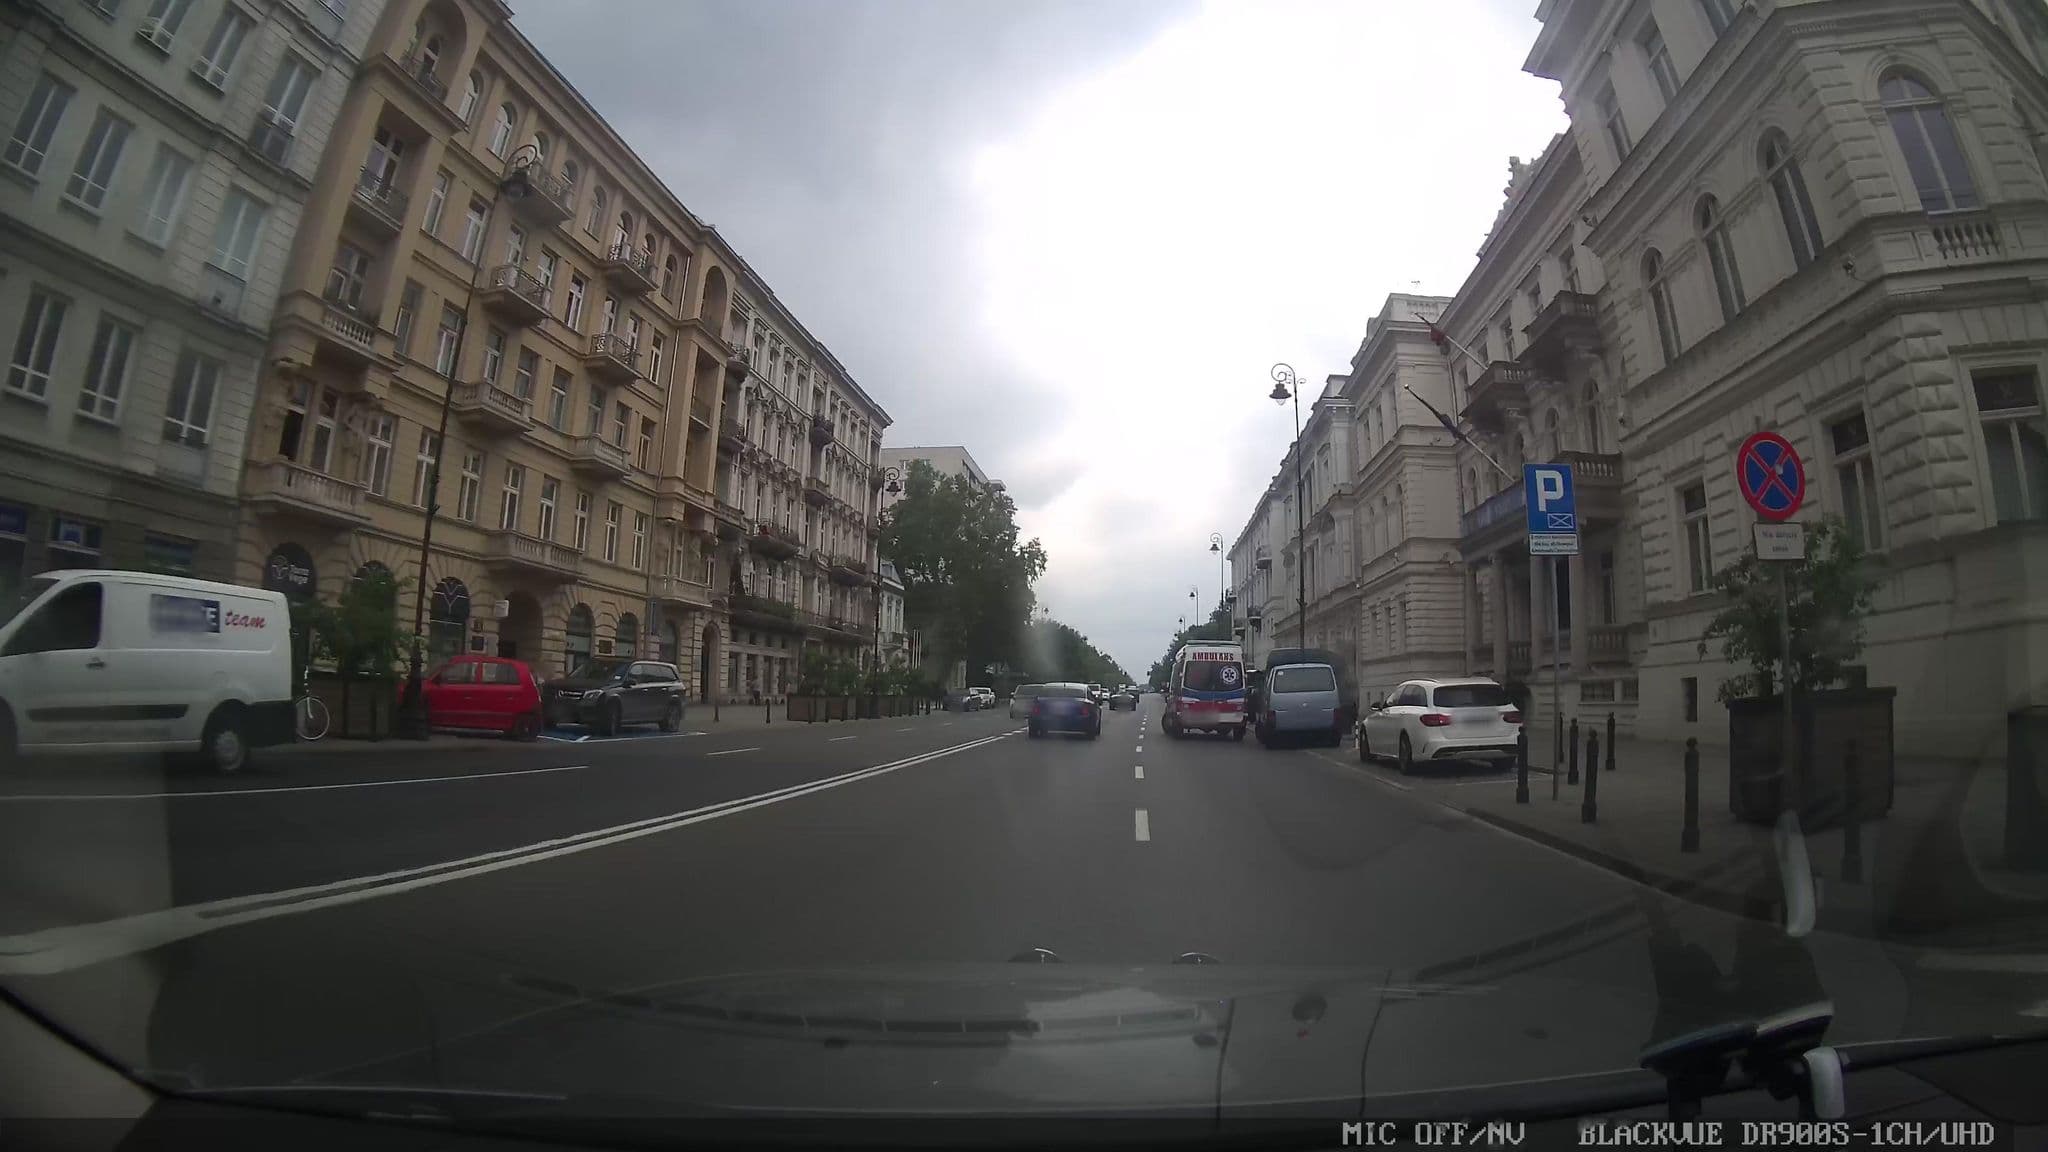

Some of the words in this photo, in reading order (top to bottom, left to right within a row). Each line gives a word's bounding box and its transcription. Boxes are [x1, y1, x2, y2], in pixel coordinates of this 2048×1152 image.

[1535, 469, 1564, 512] P
[225, 610, 266, 629] team
[1192, 652, 1234, 661] AMBULANS
